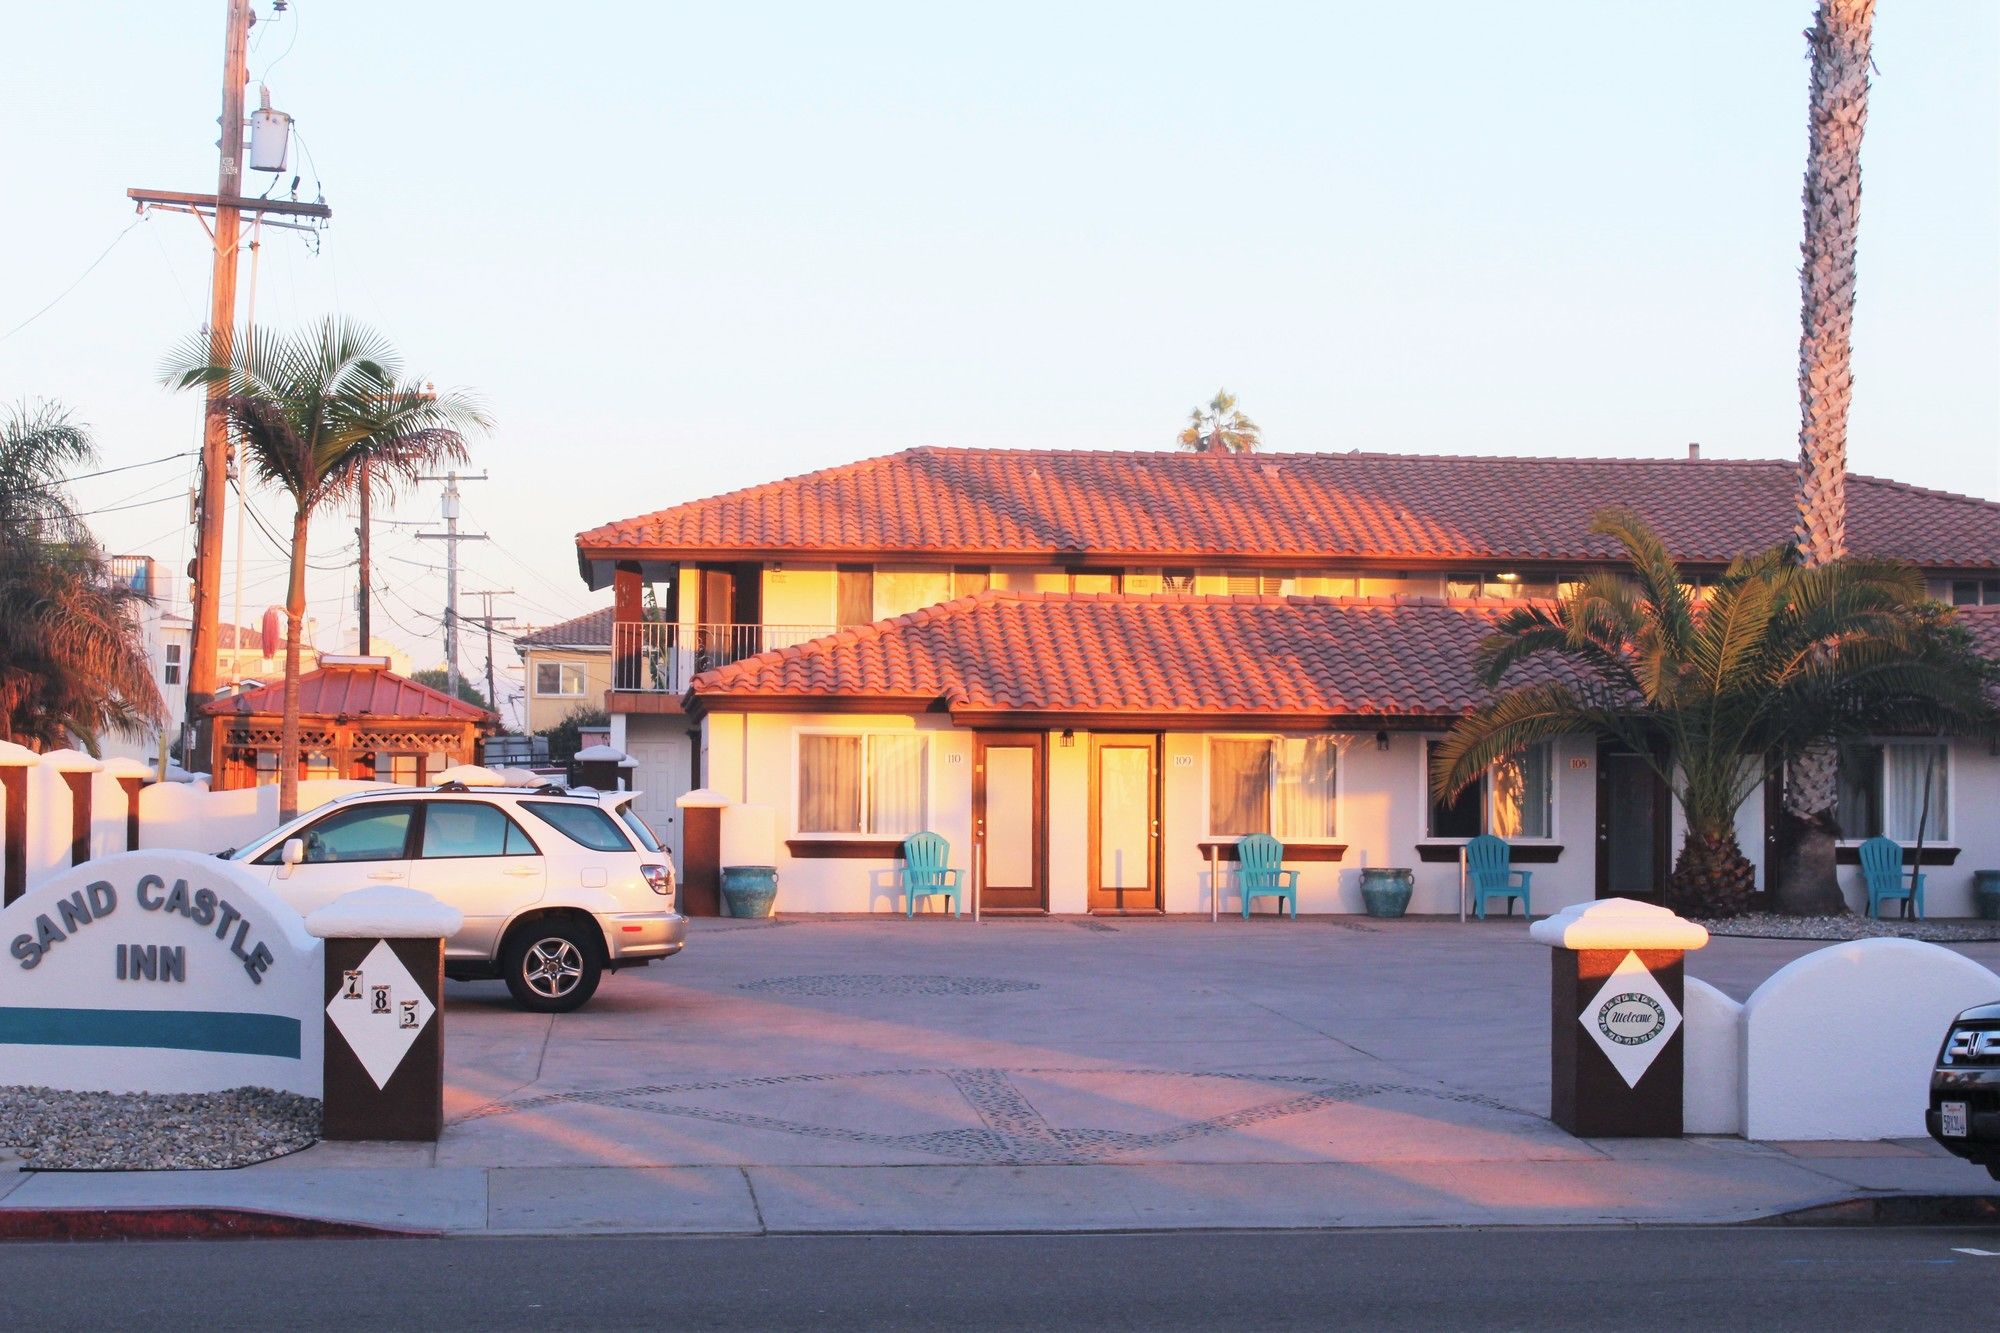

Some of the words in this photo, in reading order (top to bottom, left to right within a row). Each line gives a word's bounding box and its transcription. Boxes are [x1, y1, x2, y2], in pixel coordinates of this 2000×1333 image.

[10, 880, 118, 970] SAND
[136, 874, 274, 985] CASTLE
[116, 944, 186, 983] INN
[1611, 1011, 1652, 1024] Welcome
